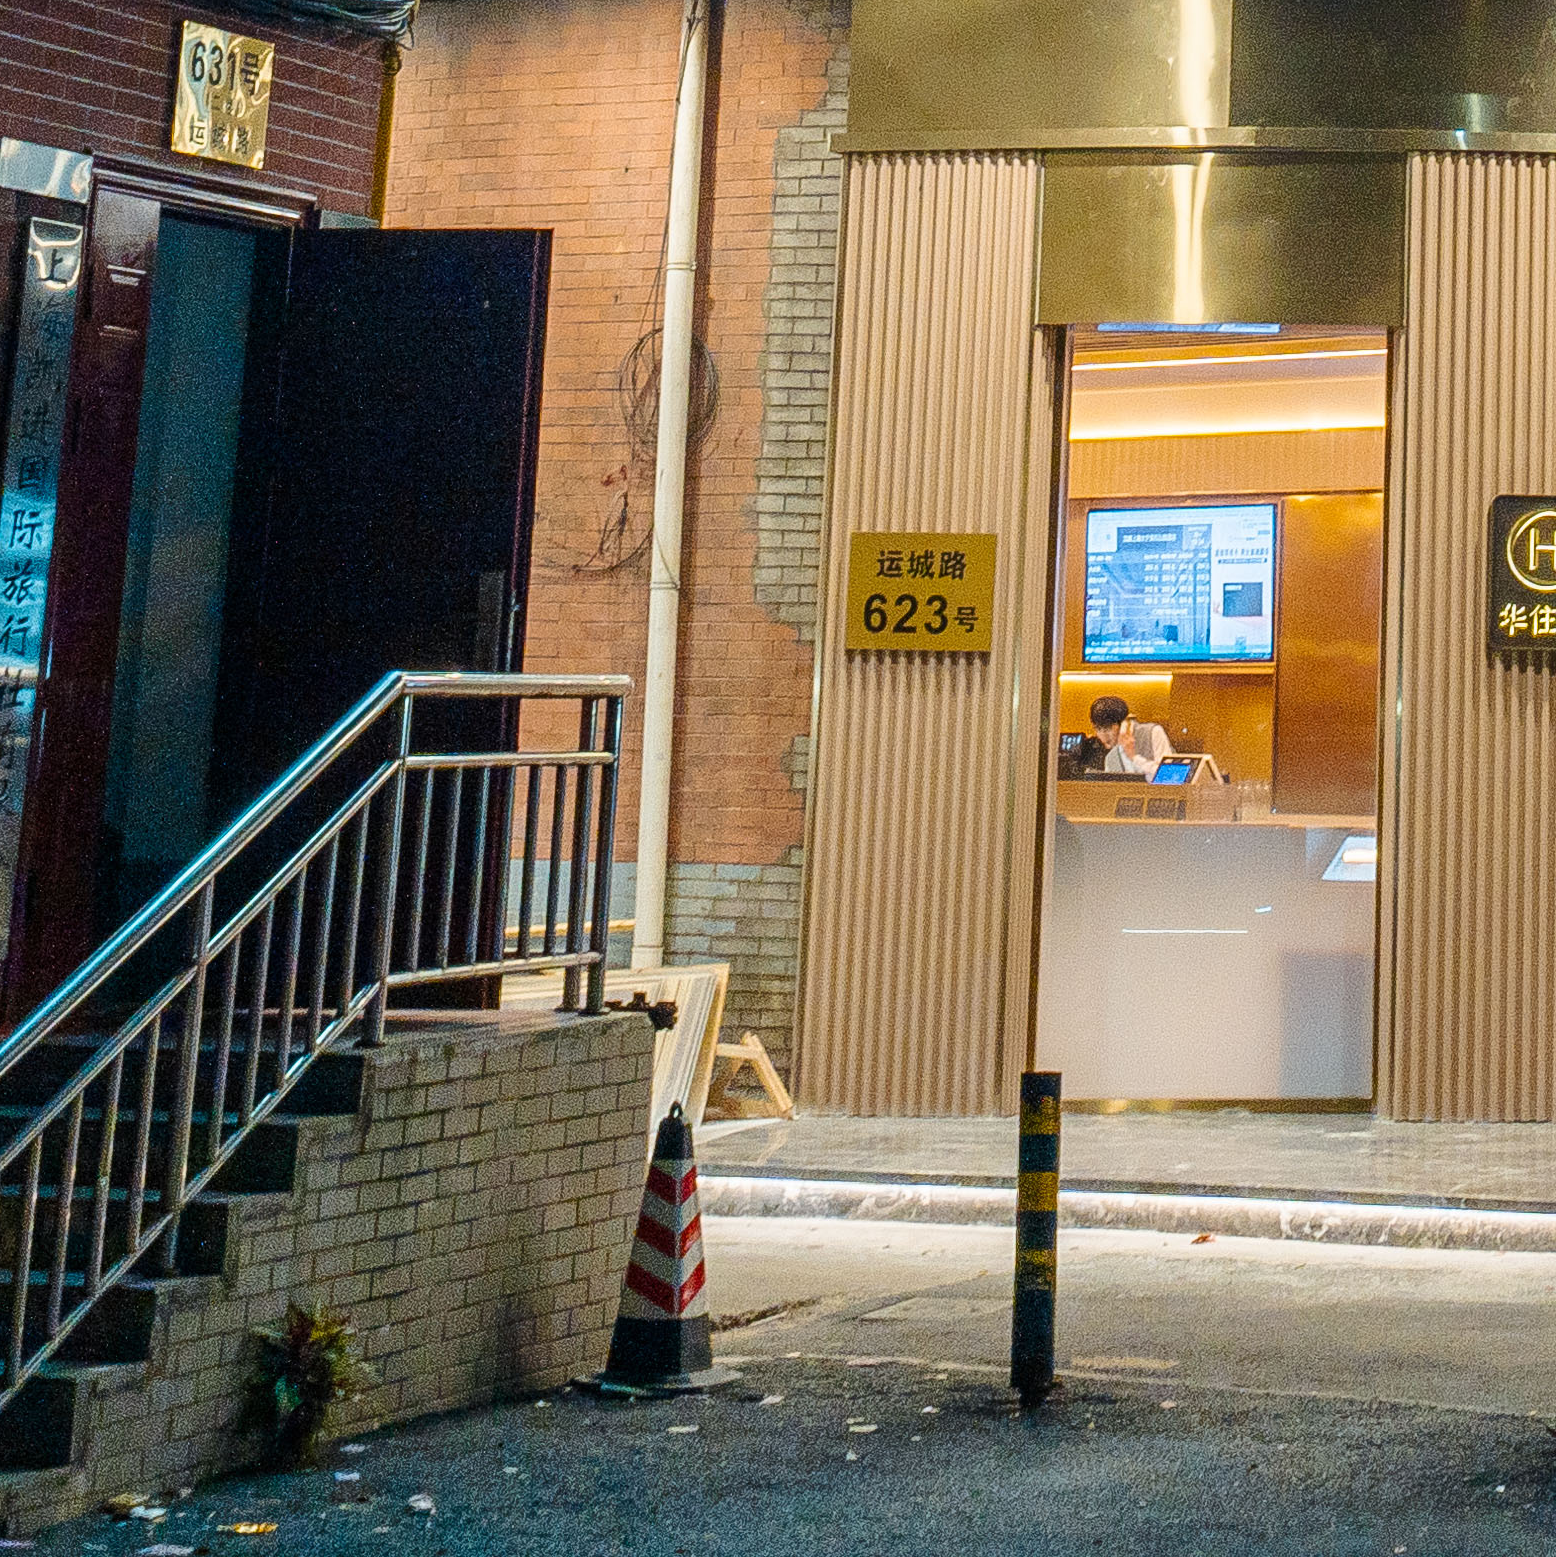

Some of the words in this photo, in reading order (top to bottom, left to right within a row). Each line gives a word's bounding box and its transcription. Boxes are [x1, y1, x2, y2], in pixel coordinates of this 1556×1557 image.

[191, 40, 260, 97] 631号
[876, 548, 967, 581] 运城路
[863, 592, 979, 636] 623号
